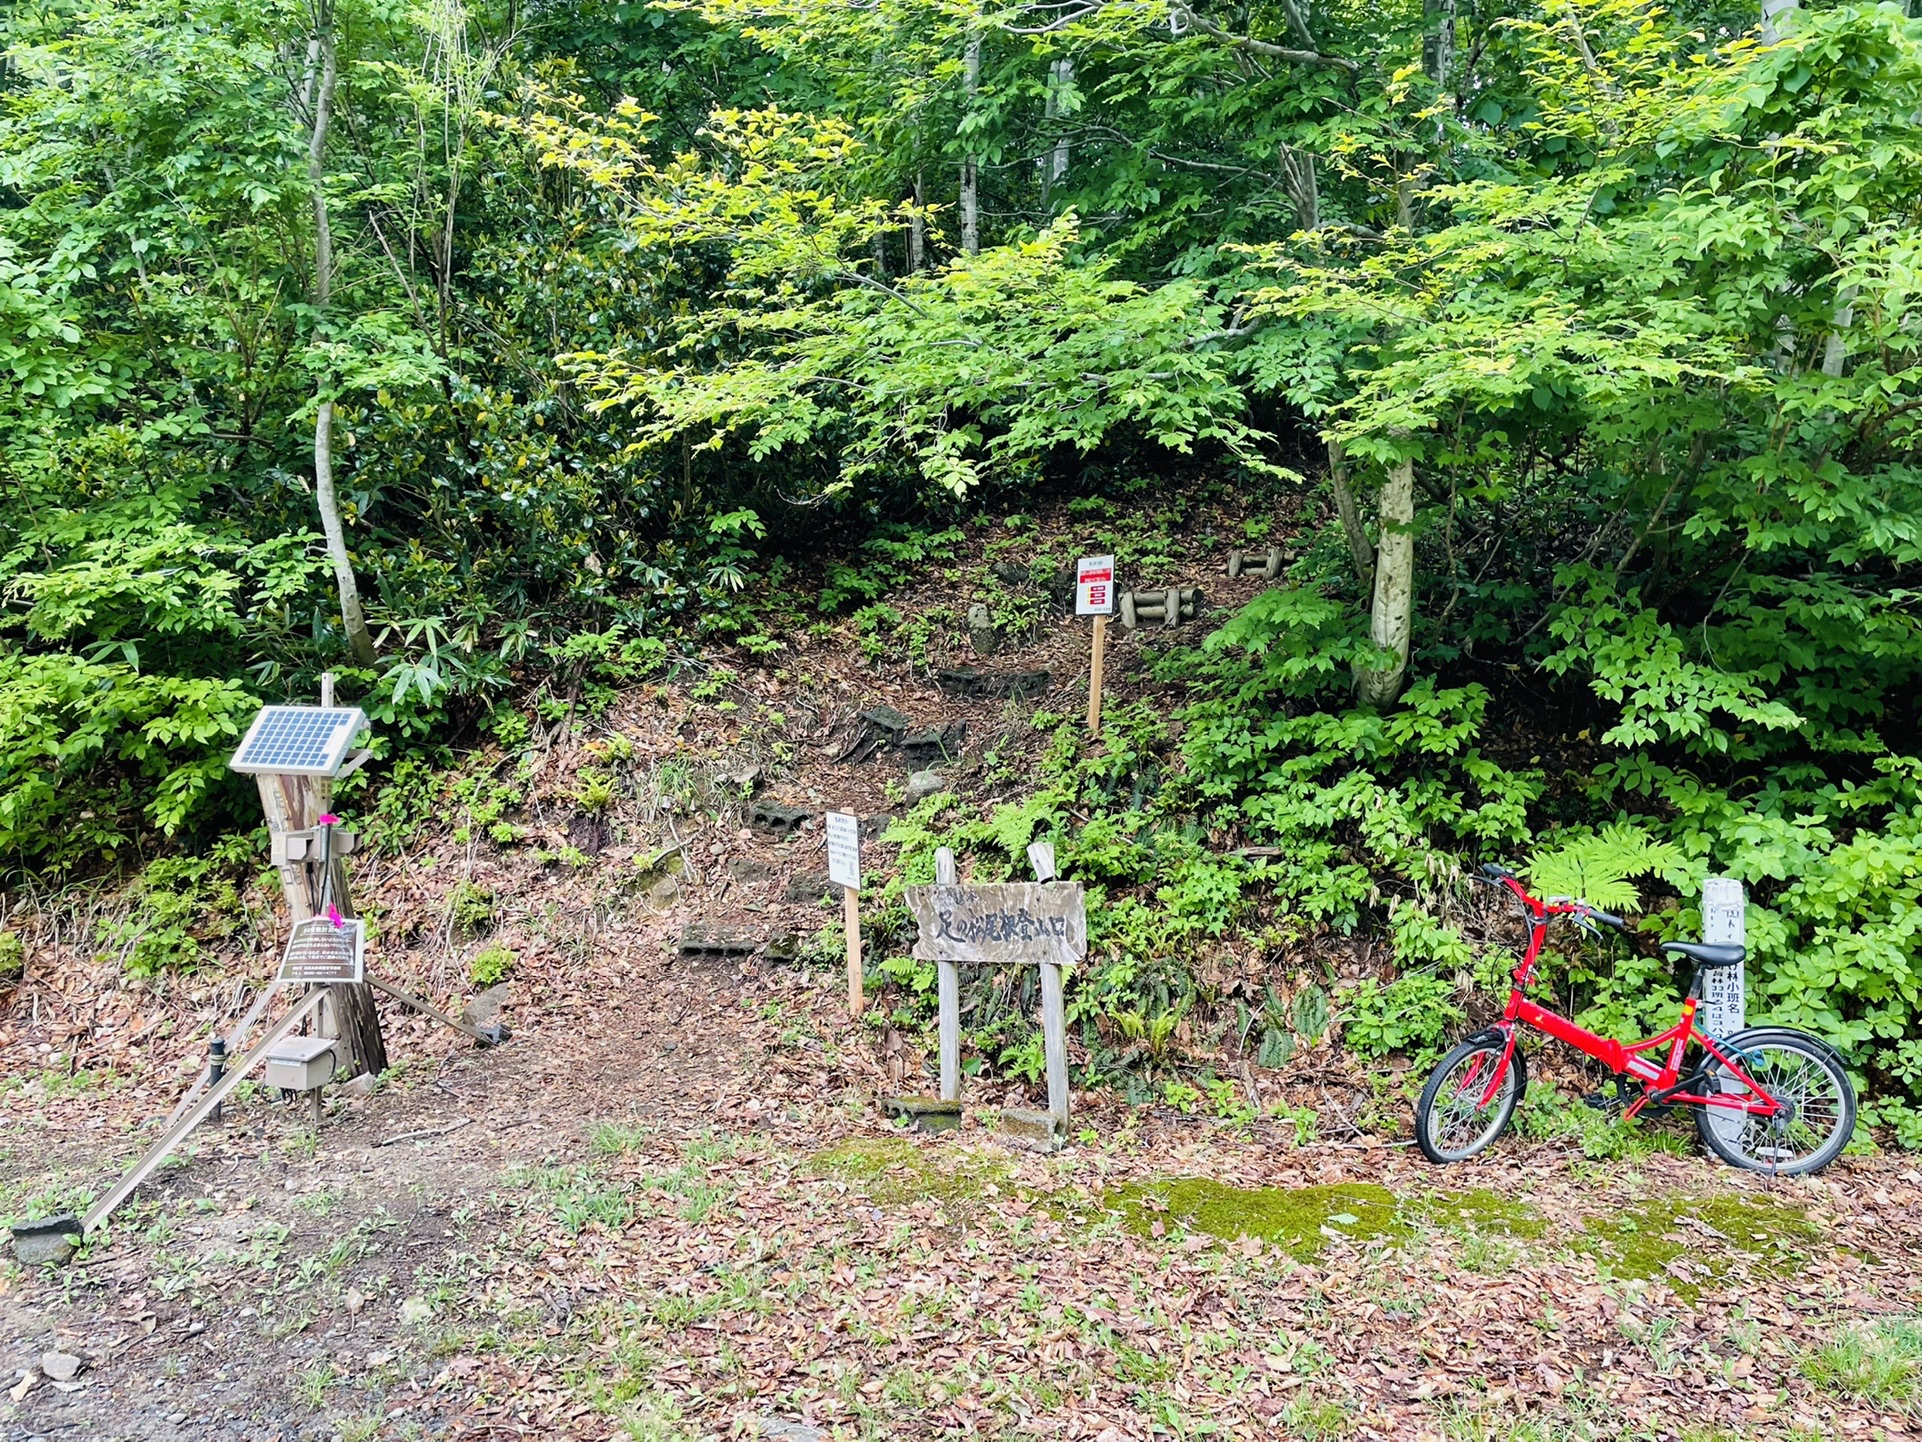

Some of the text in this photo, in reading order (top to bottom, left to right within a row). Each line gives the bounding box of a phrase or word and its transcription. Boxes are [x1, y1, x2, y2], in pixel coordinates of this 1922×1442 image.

[936, 908, 1065, 944] 足の松尾根登山口
